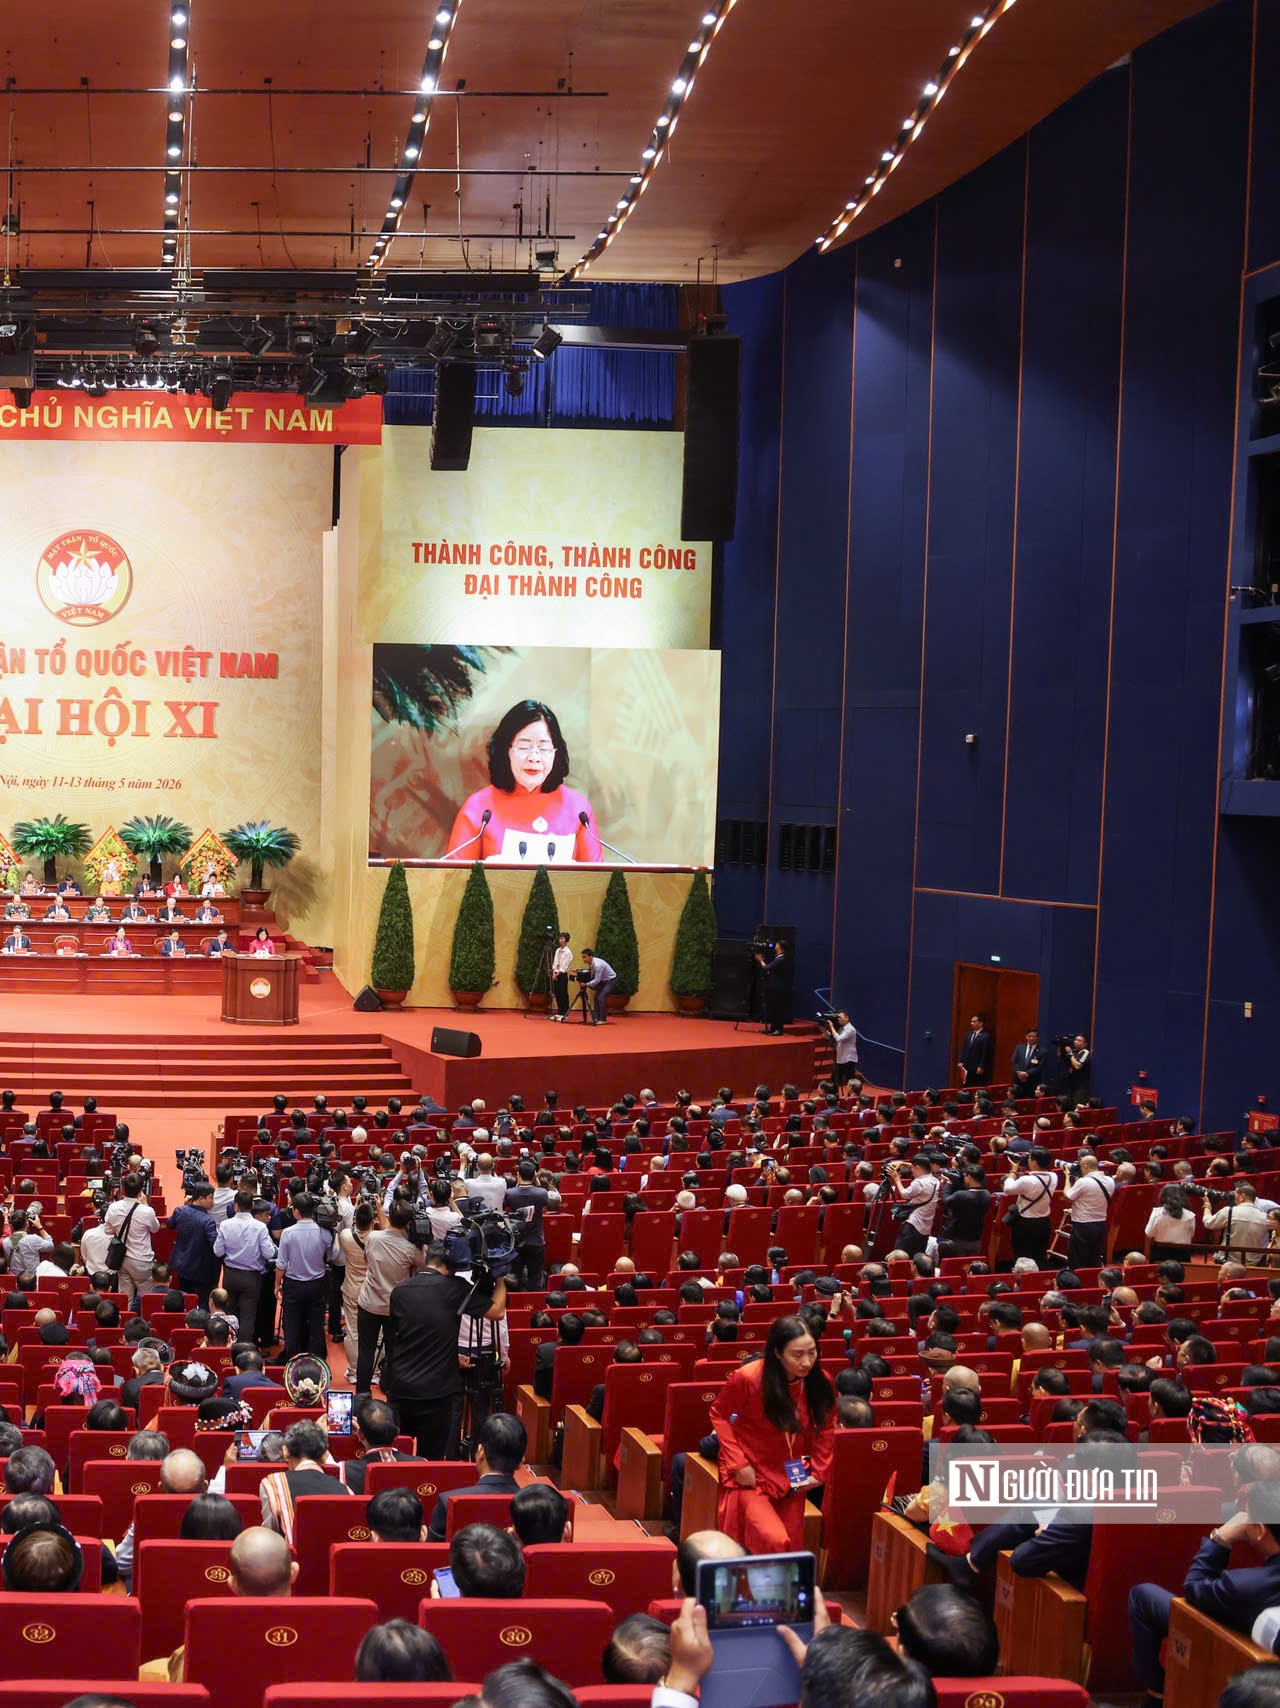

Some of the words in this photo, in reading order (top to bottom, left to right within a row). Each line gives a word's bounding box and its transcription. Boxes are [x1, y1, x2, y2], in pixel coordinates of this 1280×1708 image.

[74, 401, 173, 429] NGHĨA
[183, 404, 254, 435] VIỆT
[264, 407, 333, 432] NAM
[411, 539, 481, 565] THÀNH
[489, 540, 553, 569] CÔNG,
[562, 542, 631, 569] THÀNH
[639, 543, 696, 570] CÔNG
[463, 574, 500, 600] ĐẠI
[507, 571, 577, 597] THÀNH
[585, 572, 642, 599] CÔNG
[84, 608, 105, 618] NAM
[34, 638, 67, 676] TỔ
[75, 640, 146, 677] QUỐC
[155, 645, 212, 683] VIỆT
[220, 651, 279, 679] NAM
[56, 686, 150, 747] HỘI
[163, 700, 219, 739] XI
[22, 776, 50, 789] ngày
[52, 776, 81, 787] 11-13
[84, 777, 116, 791] tháng
[118, 778, 125, 788] 5
[127, 778, 152, 789] năm
[155, 778, 182, 790] 2026
[112, 1446, 123, 1454] 26
[135, 1484, 147, 1493] 26
[421, 1485, 433, 1494] 24
[352, 1529, 366, 1538] 25
[210, 1567, 225, 1578] 29
[405, 1572, 423, 1583] 28
[593, 1573, 610, 1583] 27
[29, 1626, 49, 1639] 32
[272, 1630, 289, 1642] 31
[506, 1631, 525, 1642] 30
